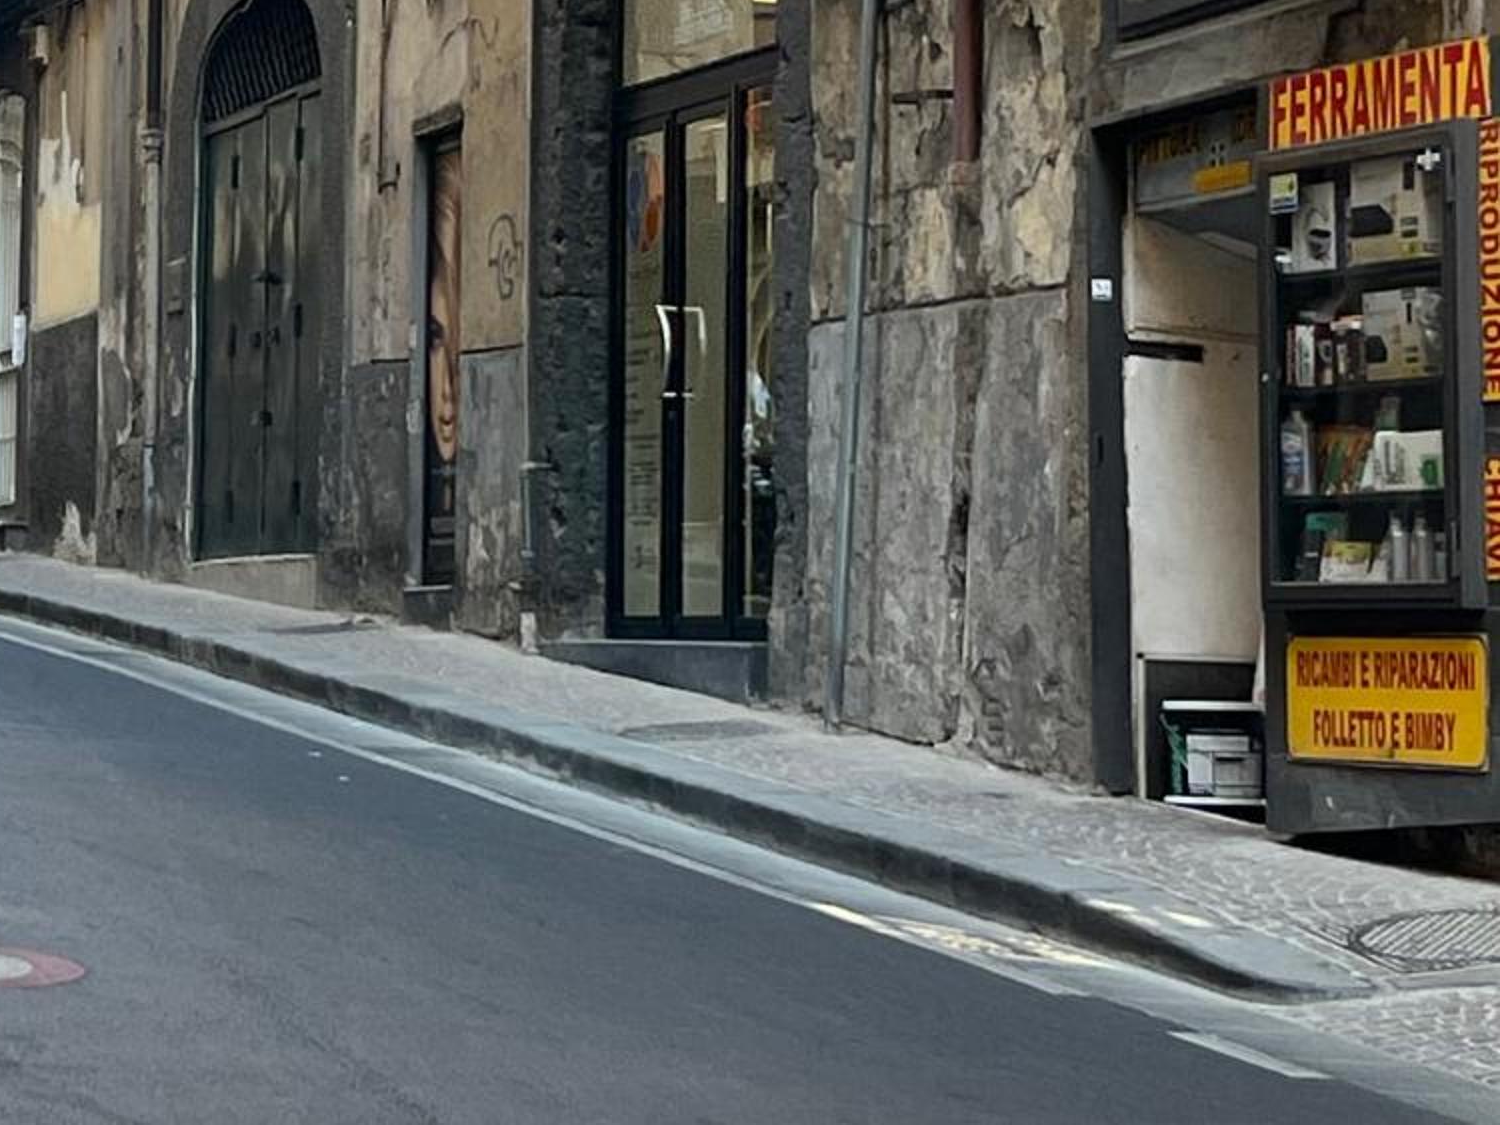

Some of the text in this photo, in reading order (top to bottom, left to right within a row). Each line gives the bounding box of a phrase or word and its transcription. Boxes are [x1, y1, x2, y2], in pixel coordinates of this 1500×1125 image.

[1272, 40, 1487, 149] FERRAMENTA
[1481, 123, 1500, 395] RIPRODUZIONE
[1296, 650, 1476, 690] RICAMBI E RIPARAZIONI
[1313, 709, 1456, 751] FOLLETTO E BIMBY
